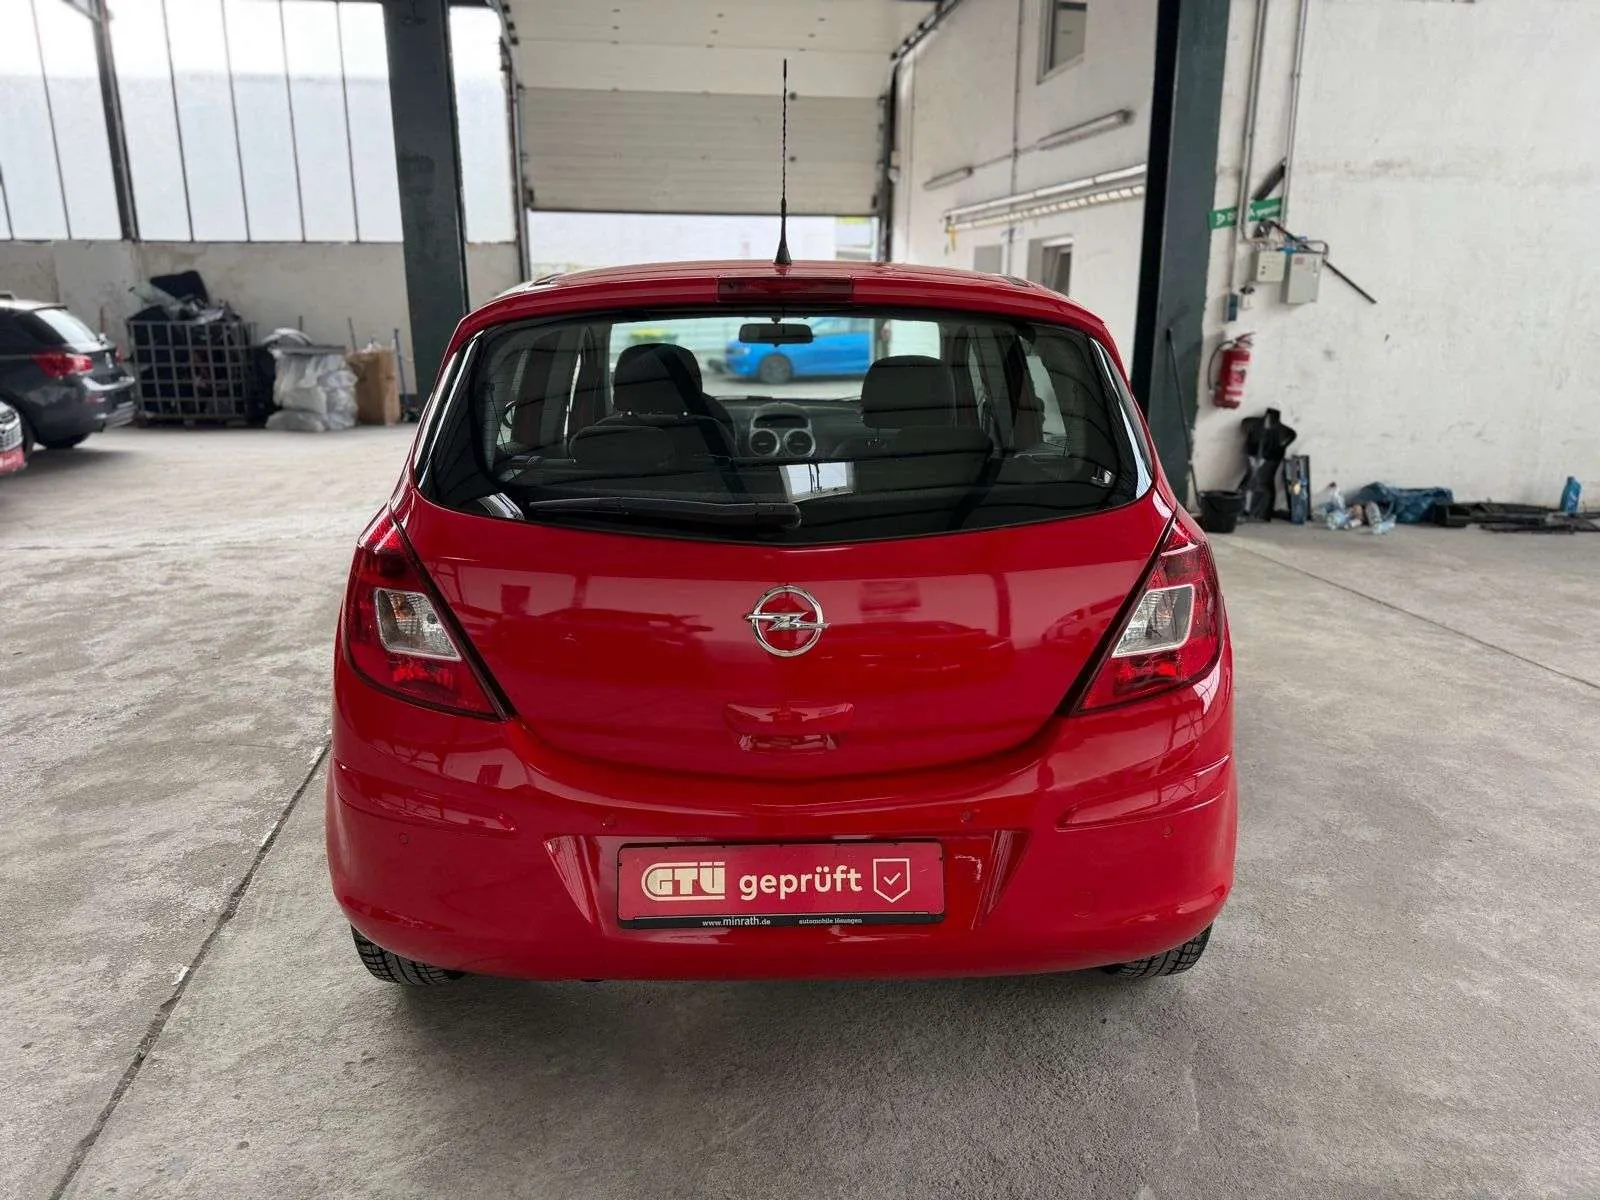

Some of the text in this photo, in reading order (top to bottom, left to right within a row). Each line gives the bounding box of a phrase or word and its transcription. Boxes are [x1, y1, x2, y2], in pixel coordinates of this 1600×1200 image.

[642, 861, 863, 901] GTÜ geprüft
[702, 916, 771, 927] www.minrath.de
[799, 917, 833, 925] automobile
